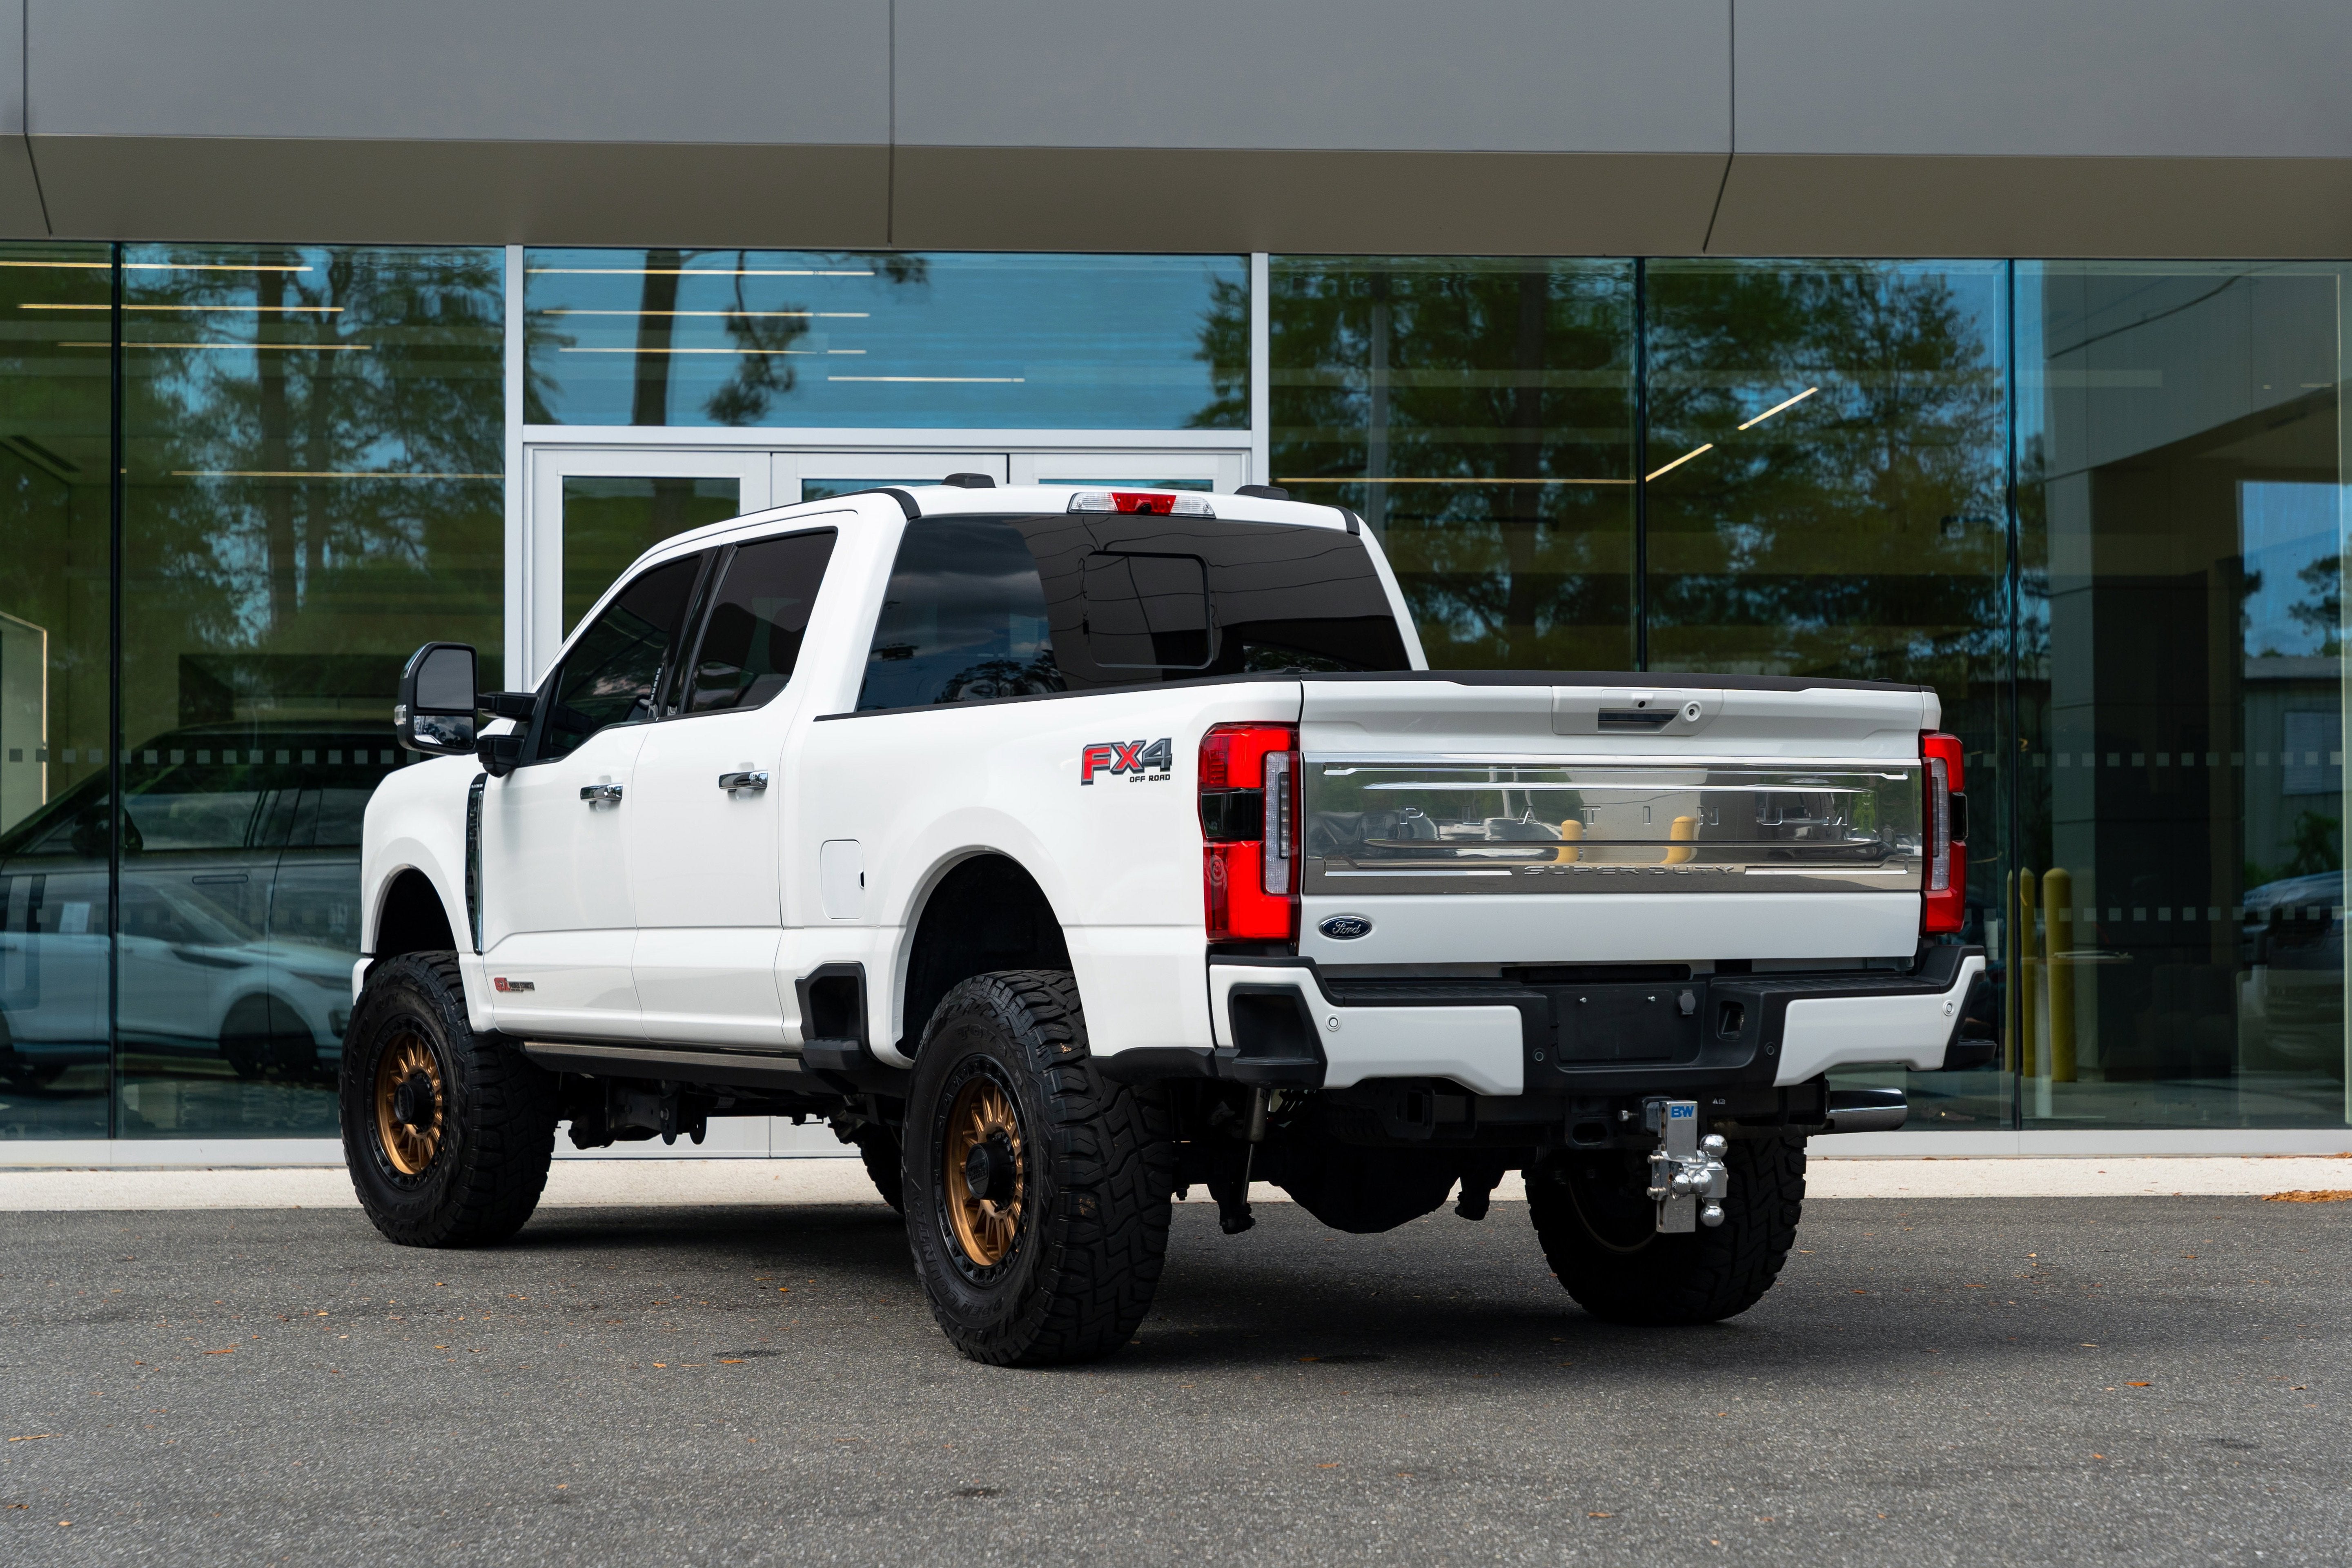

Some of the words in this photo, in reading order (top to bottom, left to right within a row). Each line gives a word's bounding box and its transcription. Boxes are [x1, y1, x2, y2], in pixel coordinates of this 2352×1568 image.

[1081, 737, 1172, 786] FX4
[1400, 806, 1847, 825] PLATINUM
[1524, 866, 1639, 875] SUPER
[1649, 866, 1734, 875] DUTY
[1332, 921, 1361, 934] Ford
[956, 1023, 1007, 1058] TOYO
[911, 1178, 959, 1305] COUNTRY
[960, 1296, 1004, 1319] OPEN
